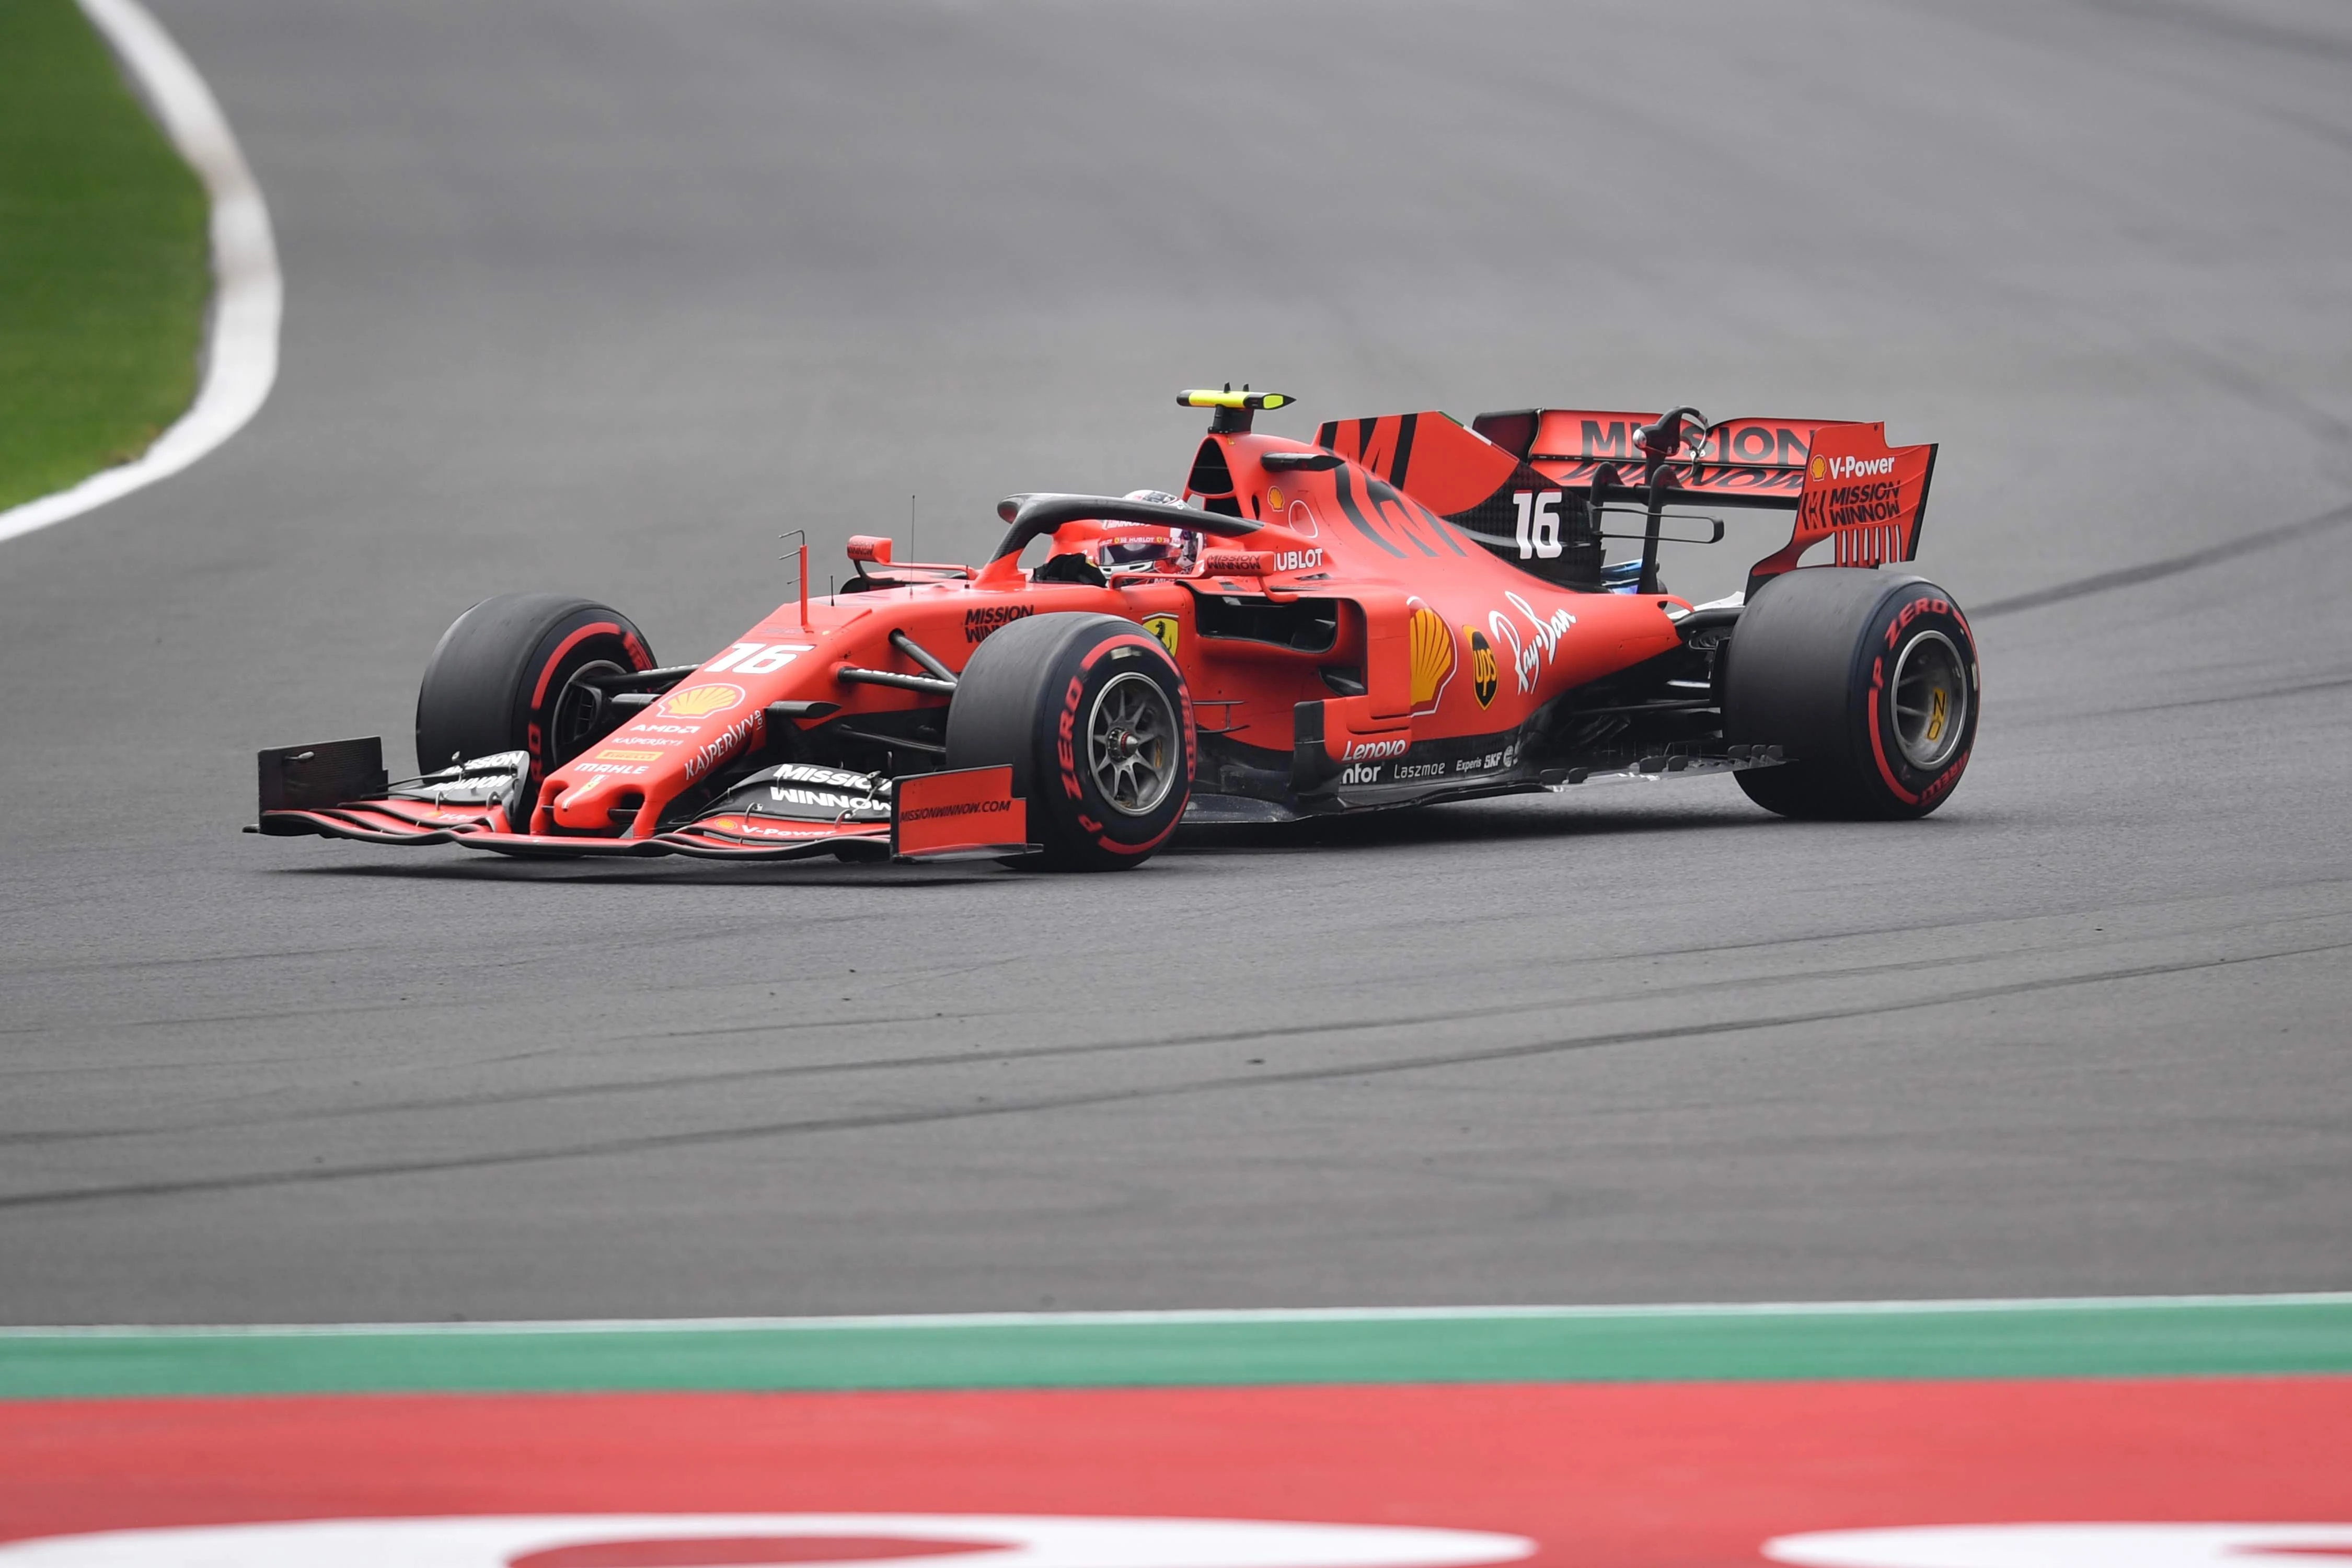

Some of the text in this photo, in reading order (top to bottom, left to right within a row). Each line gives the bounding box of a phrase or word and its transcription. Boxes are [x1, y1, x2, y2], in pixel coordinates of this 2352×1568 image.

[1581, 420, 1814, 462] MISION
[1829, 456, 1895, 480] V-Power
[1830, 480, 1900, 508] MISSION
[1513, 488, 1562, 559] 16
[1829, 500, 1900, 527] WINNOW
[1207, 562, 1261, 570] WINNOW
[965, 604, 1034, 626] MISSION
[1884, 597, 1949, 651] ZERO
[965, 624, 1001, 643] WIN
[704, 643, 817, 674] 16
[630, 724, 684, 733] AMD
[1058, 675, 1083, 800] ZERO
[612, 737, 676, 746] KASPERSKY
[684, 714, 754, 780] KASPERSKY
[1342, 740, 1406, 762] Lenovo
[574, 763, 649, 775] MAHLE
[1340, 752, 1503, 784] nfor Laszmoe Experis SKF
[900, 800, 1011, 823] MISSIONWINNOW.COM
[741, 824, 837, 836] V-Power
